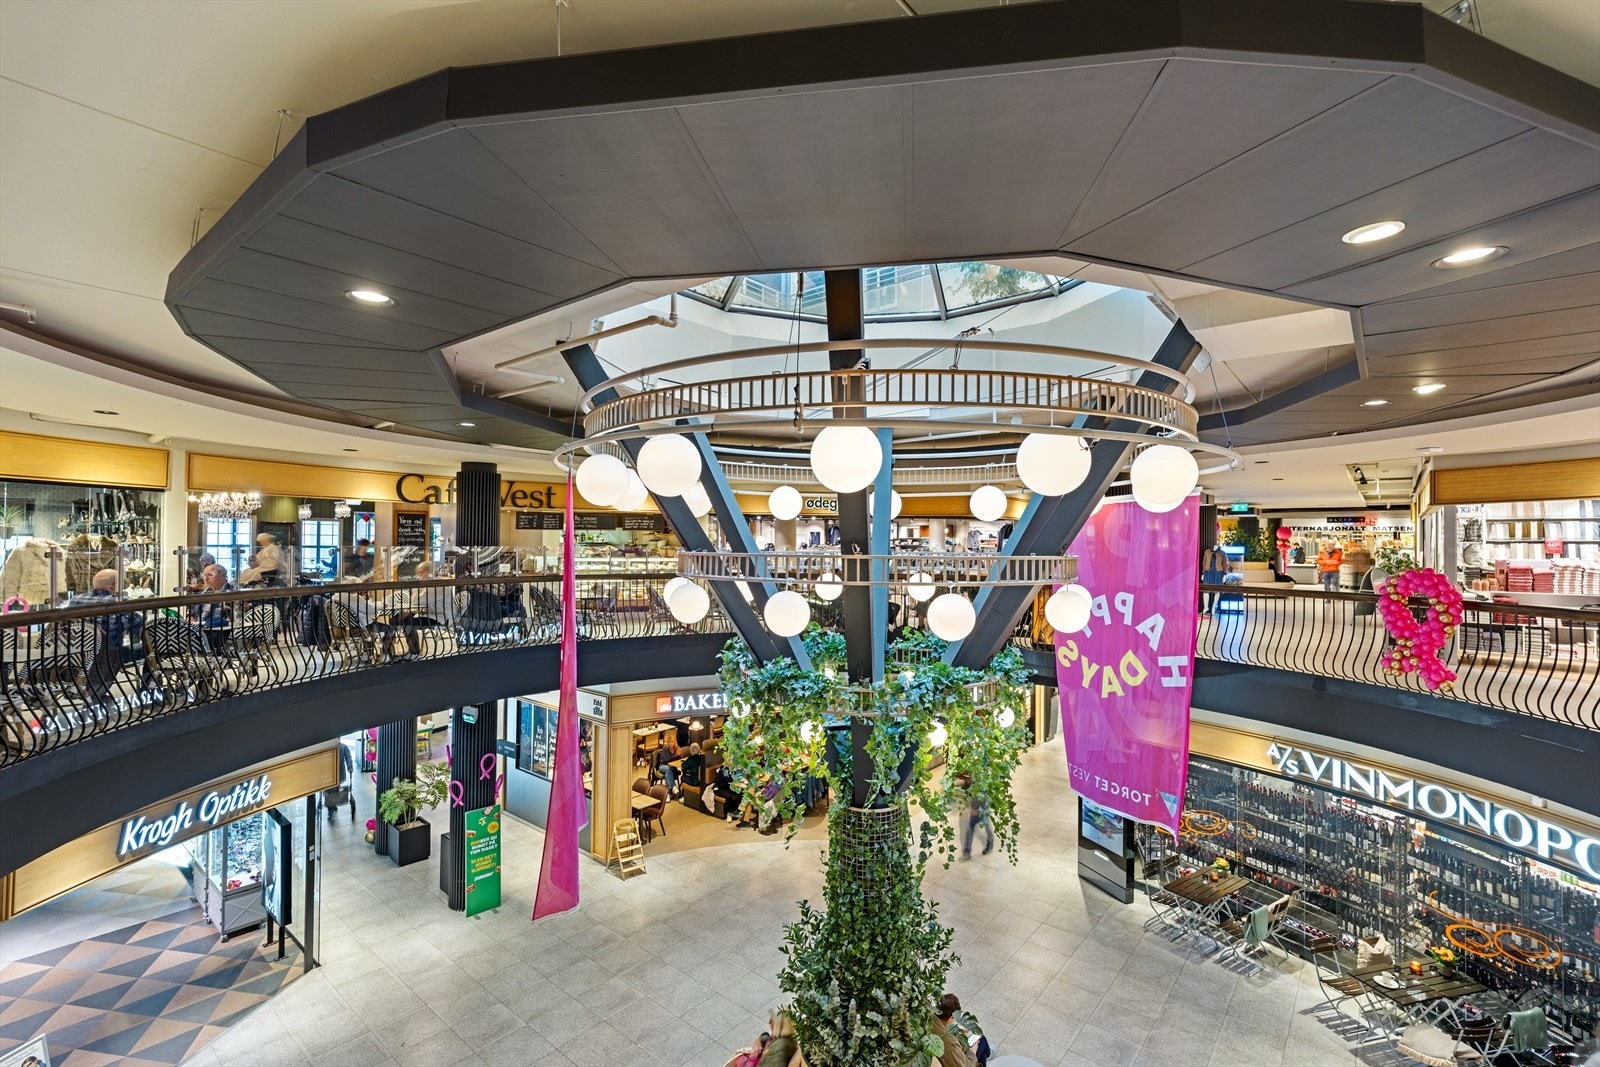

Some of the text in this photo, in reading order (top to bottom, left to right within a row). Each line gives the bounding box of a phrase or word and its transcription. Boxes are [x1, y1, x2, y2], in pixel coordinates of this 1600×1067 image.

[396, 473, 457, 505] Caf
[1266, 743, 1300, 776] A/S
[120, 774, 272, 856] Krogh Optikk
